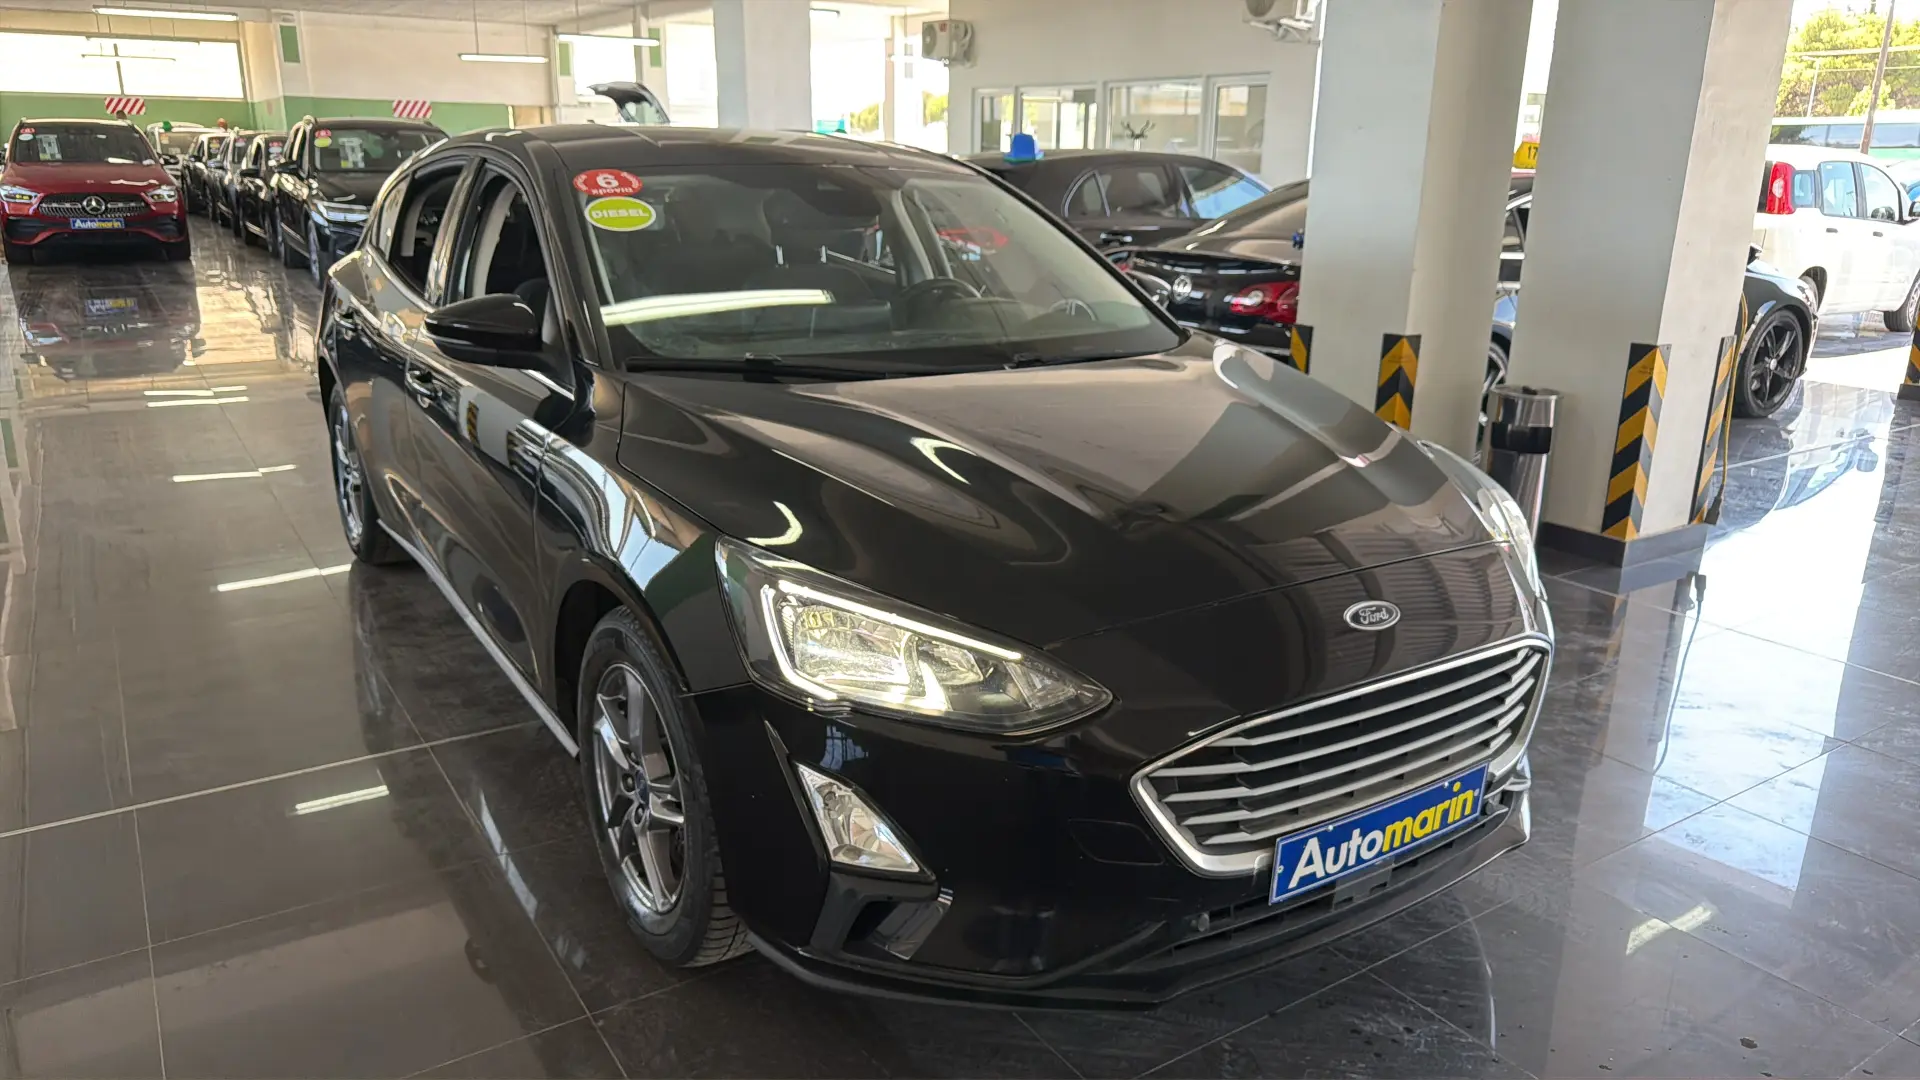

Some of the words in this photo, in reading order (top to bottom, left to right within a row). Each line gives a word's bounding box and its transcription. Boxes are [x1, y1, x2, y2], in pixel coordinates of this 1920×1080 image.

[596, 173, 619, 188] 6
[591, 208, 649, 219] DIESEL
[75, 219, 122, 229] Automarin
[1358, 606, 1389, 625] Ford
[1287, 781, 1475, 890] Automarin
